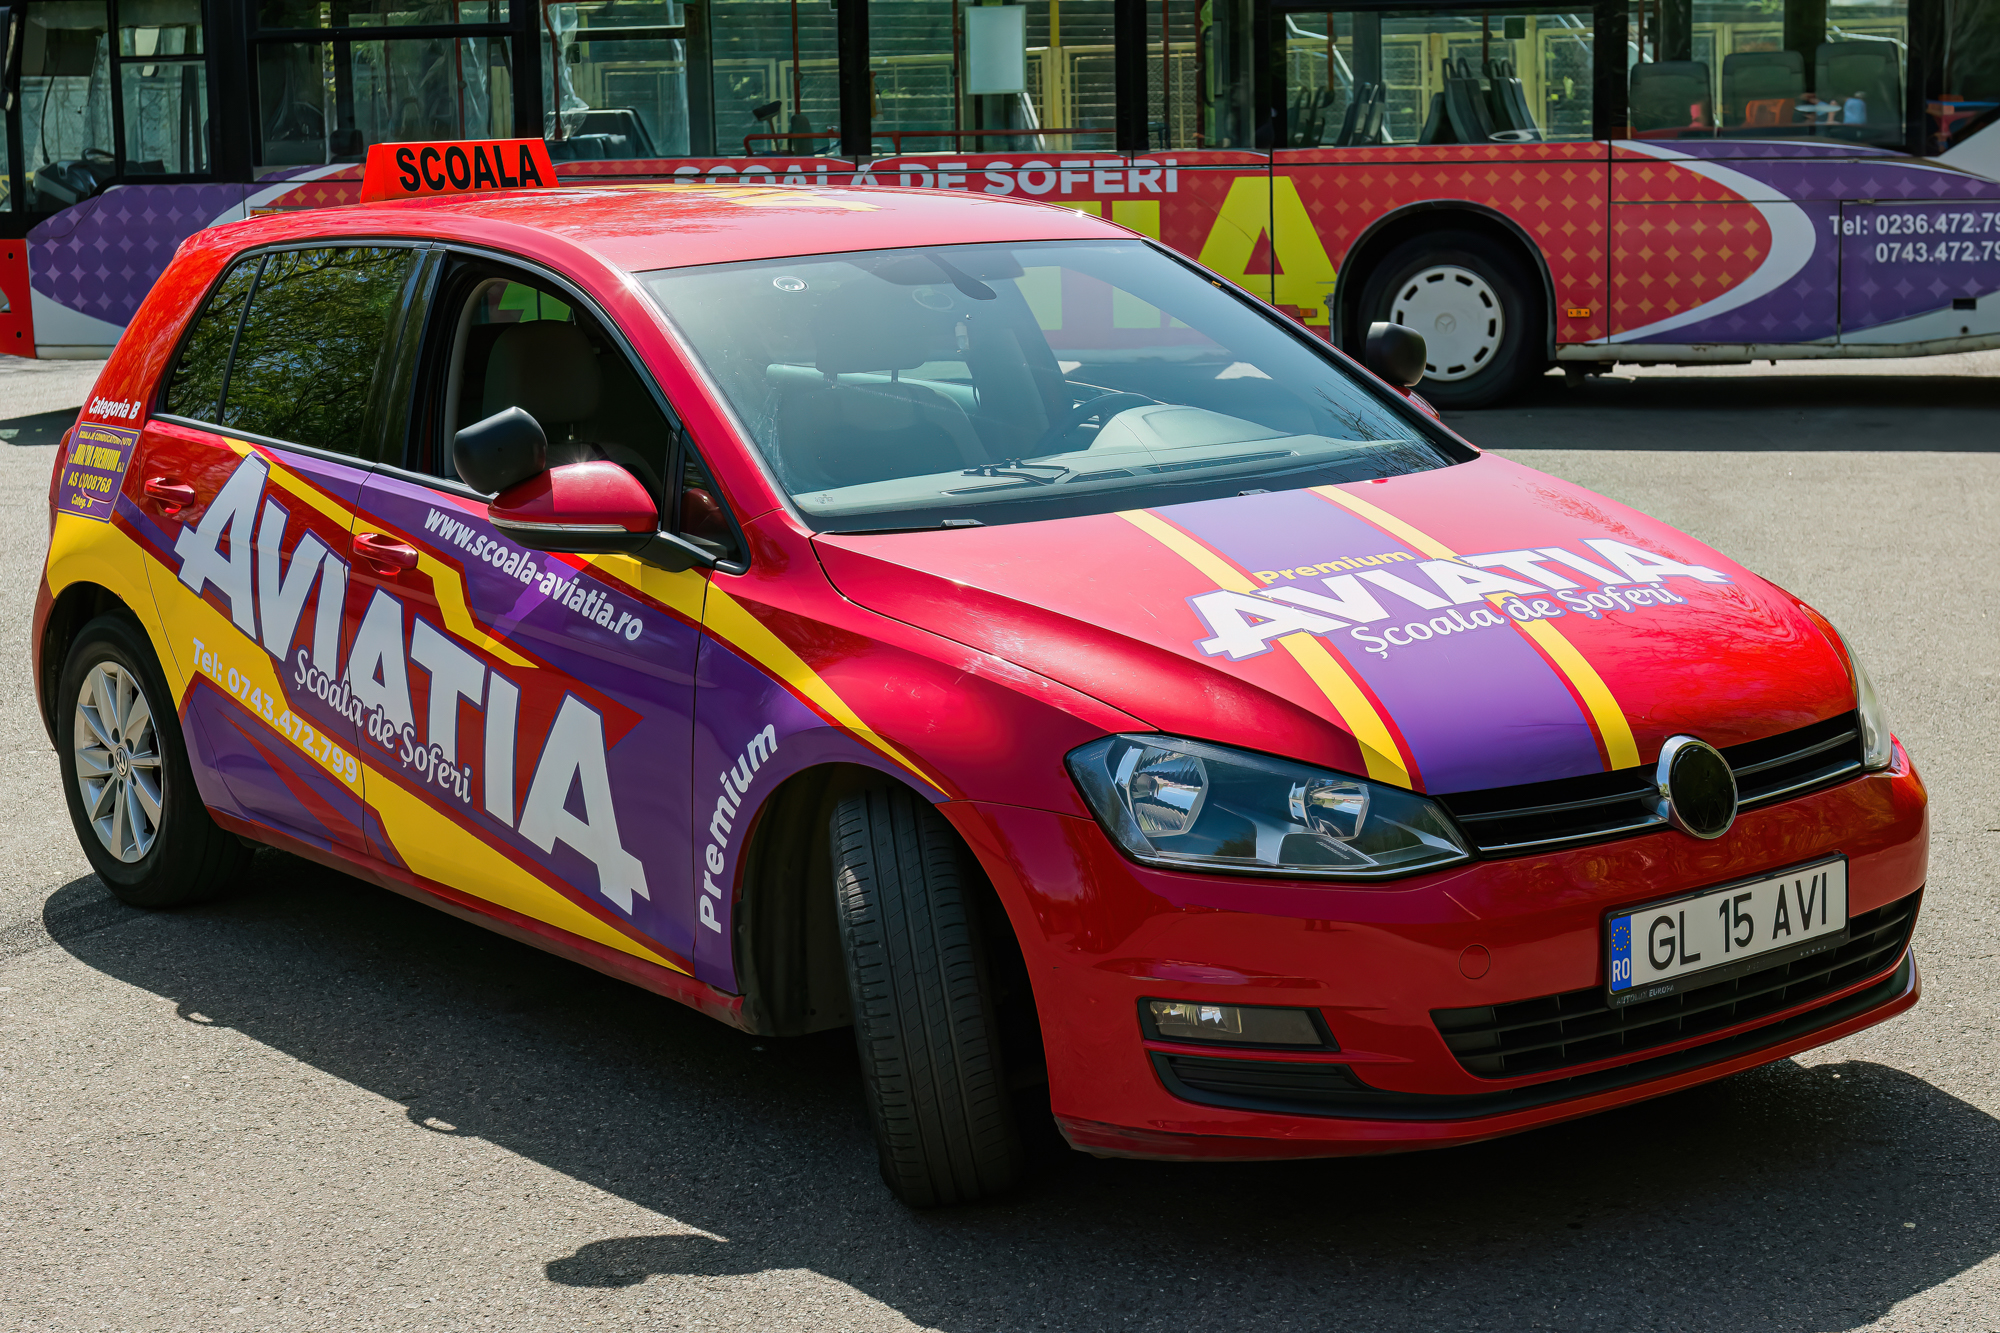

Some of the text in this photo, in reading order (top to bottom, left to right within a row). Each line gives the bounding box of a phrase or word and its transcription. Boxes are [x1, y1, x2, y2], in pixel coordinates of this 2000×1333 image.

[396, 145, 543, 191] SCOALA
[900, 162, 968, 191] DE
[984, 159, 1177, 196] SOFERI
[1829, 215, 1868, 235] Tel:
[89, 396, 141, 419] Categoria B
[68, 471, 79, 487] AS
[424, 508, 643, 641] www.scoala-aviatia.ro
[1252, 551, 1415, 584] Premium
[1191, 539, 1727, 659] AVIATIA
[1350, 583, 1683, 659] Școala de Șoferi
[174, 454, 650, 916] AVIATIA
[193, 637, 357, 783] Tel: 0743.472.799
[368, 708, 395, 748] de
[700, 724, 778, 934] Premium
[1648, 872, 1827, 970] GL 15 AVI
[1612, 957, 1630, 983] RO
